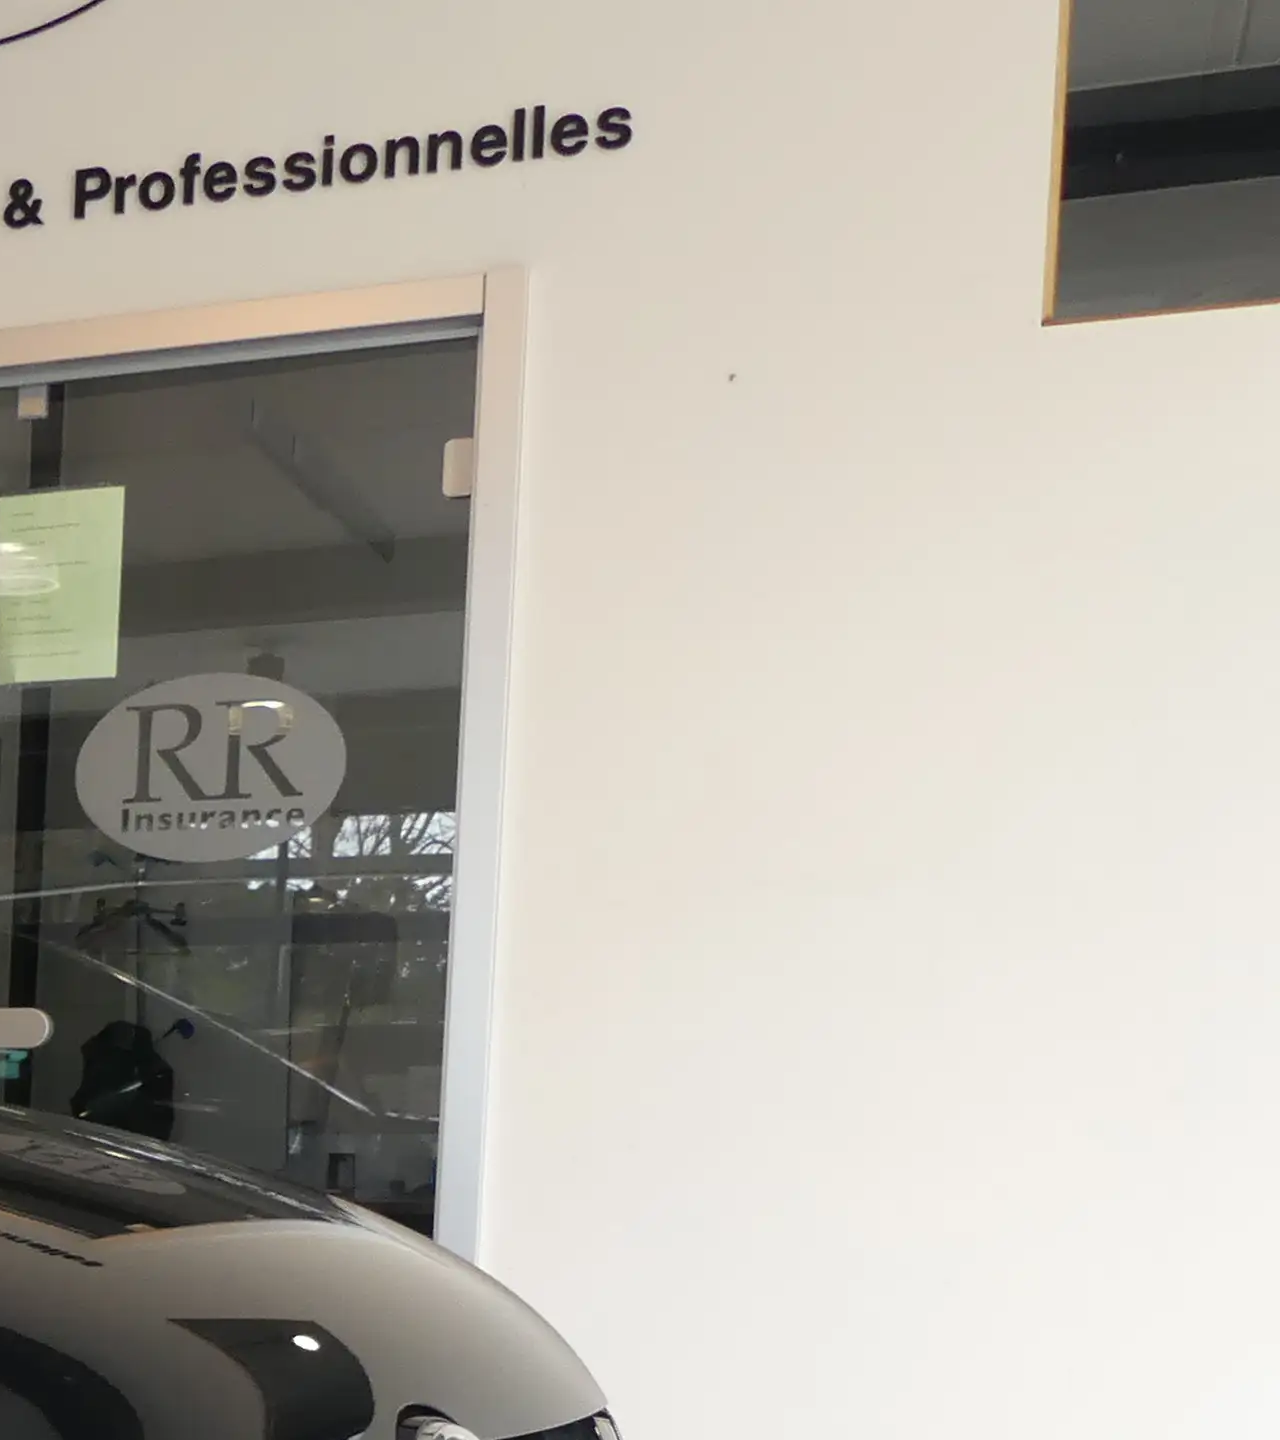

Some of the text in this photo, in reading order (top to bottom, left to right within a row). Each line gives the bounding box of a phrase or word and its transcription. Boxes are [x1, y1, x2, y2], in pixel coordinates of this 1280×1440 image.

[3, 177, 45, 230] &
[72, 104, 634, 220] Professionnelles
[122, 700, 304, 804] RR
[119, 806, 306, 834] Insurance
